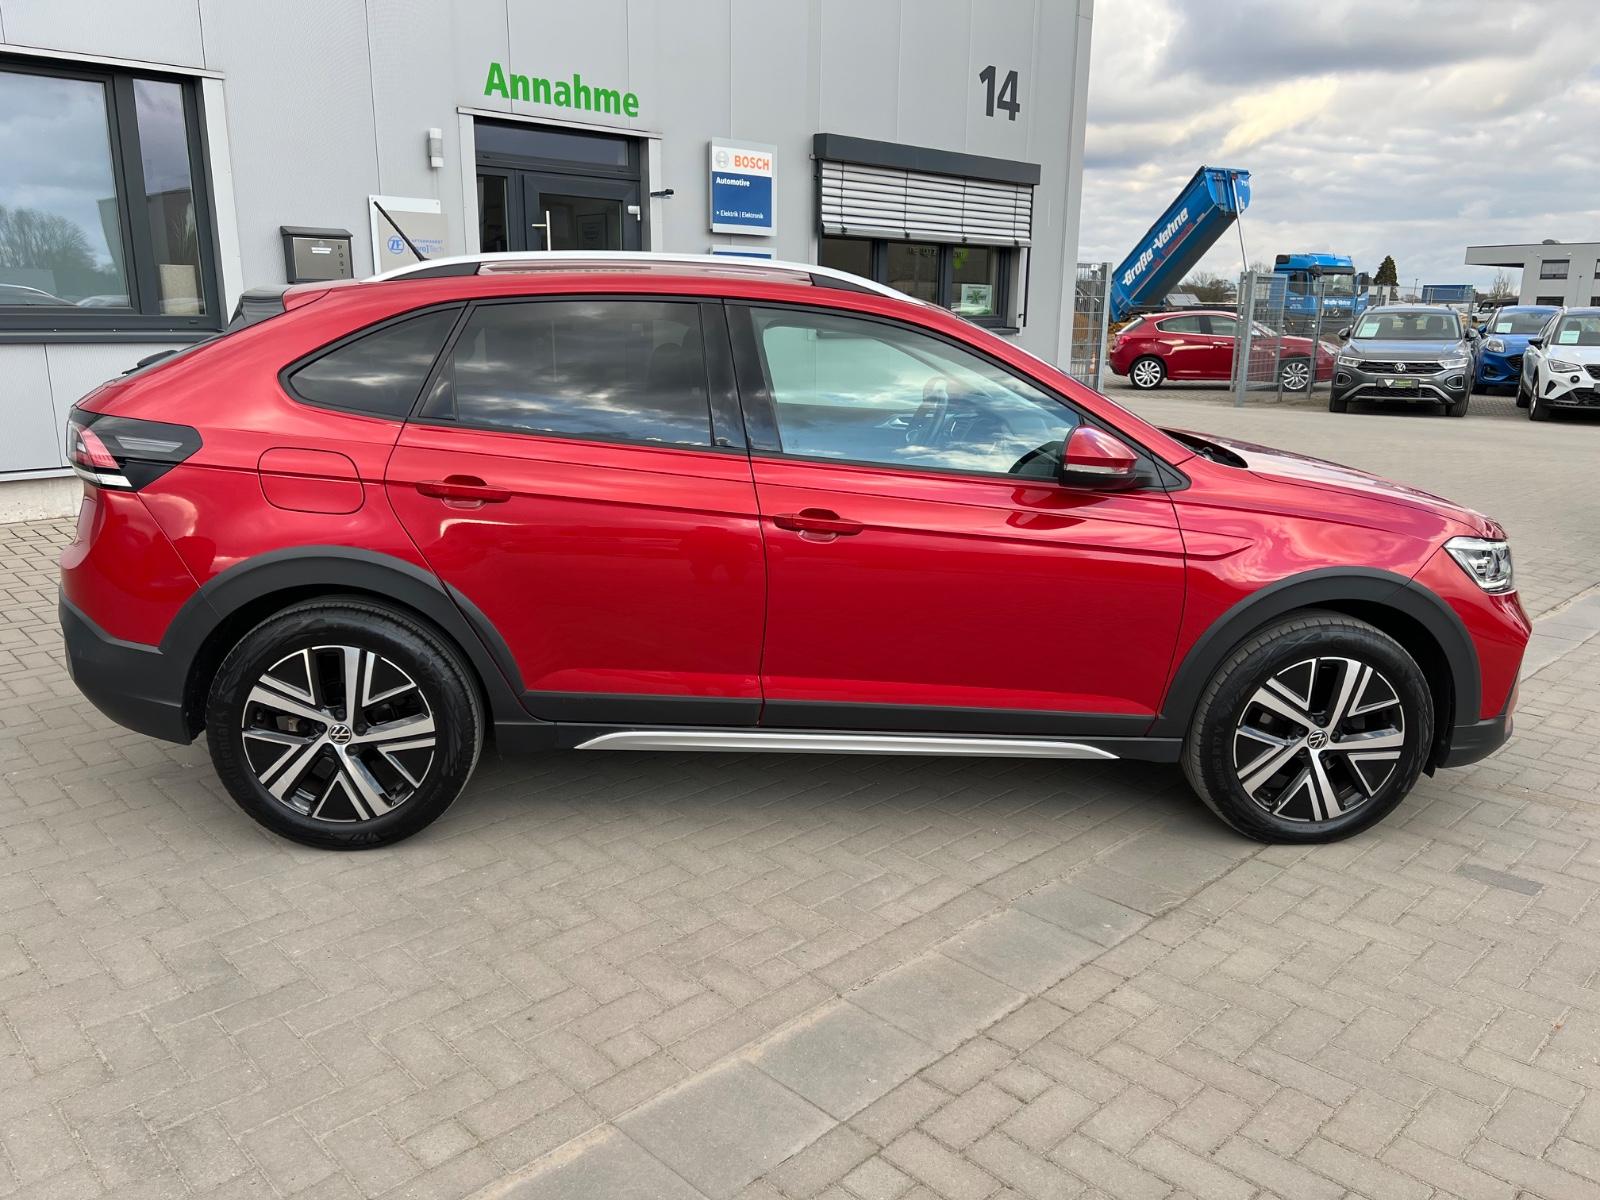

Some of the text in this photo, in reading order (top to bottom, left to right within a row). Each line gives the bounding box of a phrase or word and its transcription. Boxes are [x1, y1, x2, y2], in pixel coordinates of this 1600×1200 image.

[484, 62, 640, 117] Annahme
[979, 65, 1020, 121] 14
[734, 154, 770, 171] BOSCH
[715, 176, 751, 187] Automotive
[720, 209, 764, 220] Elektrik Elektronik
